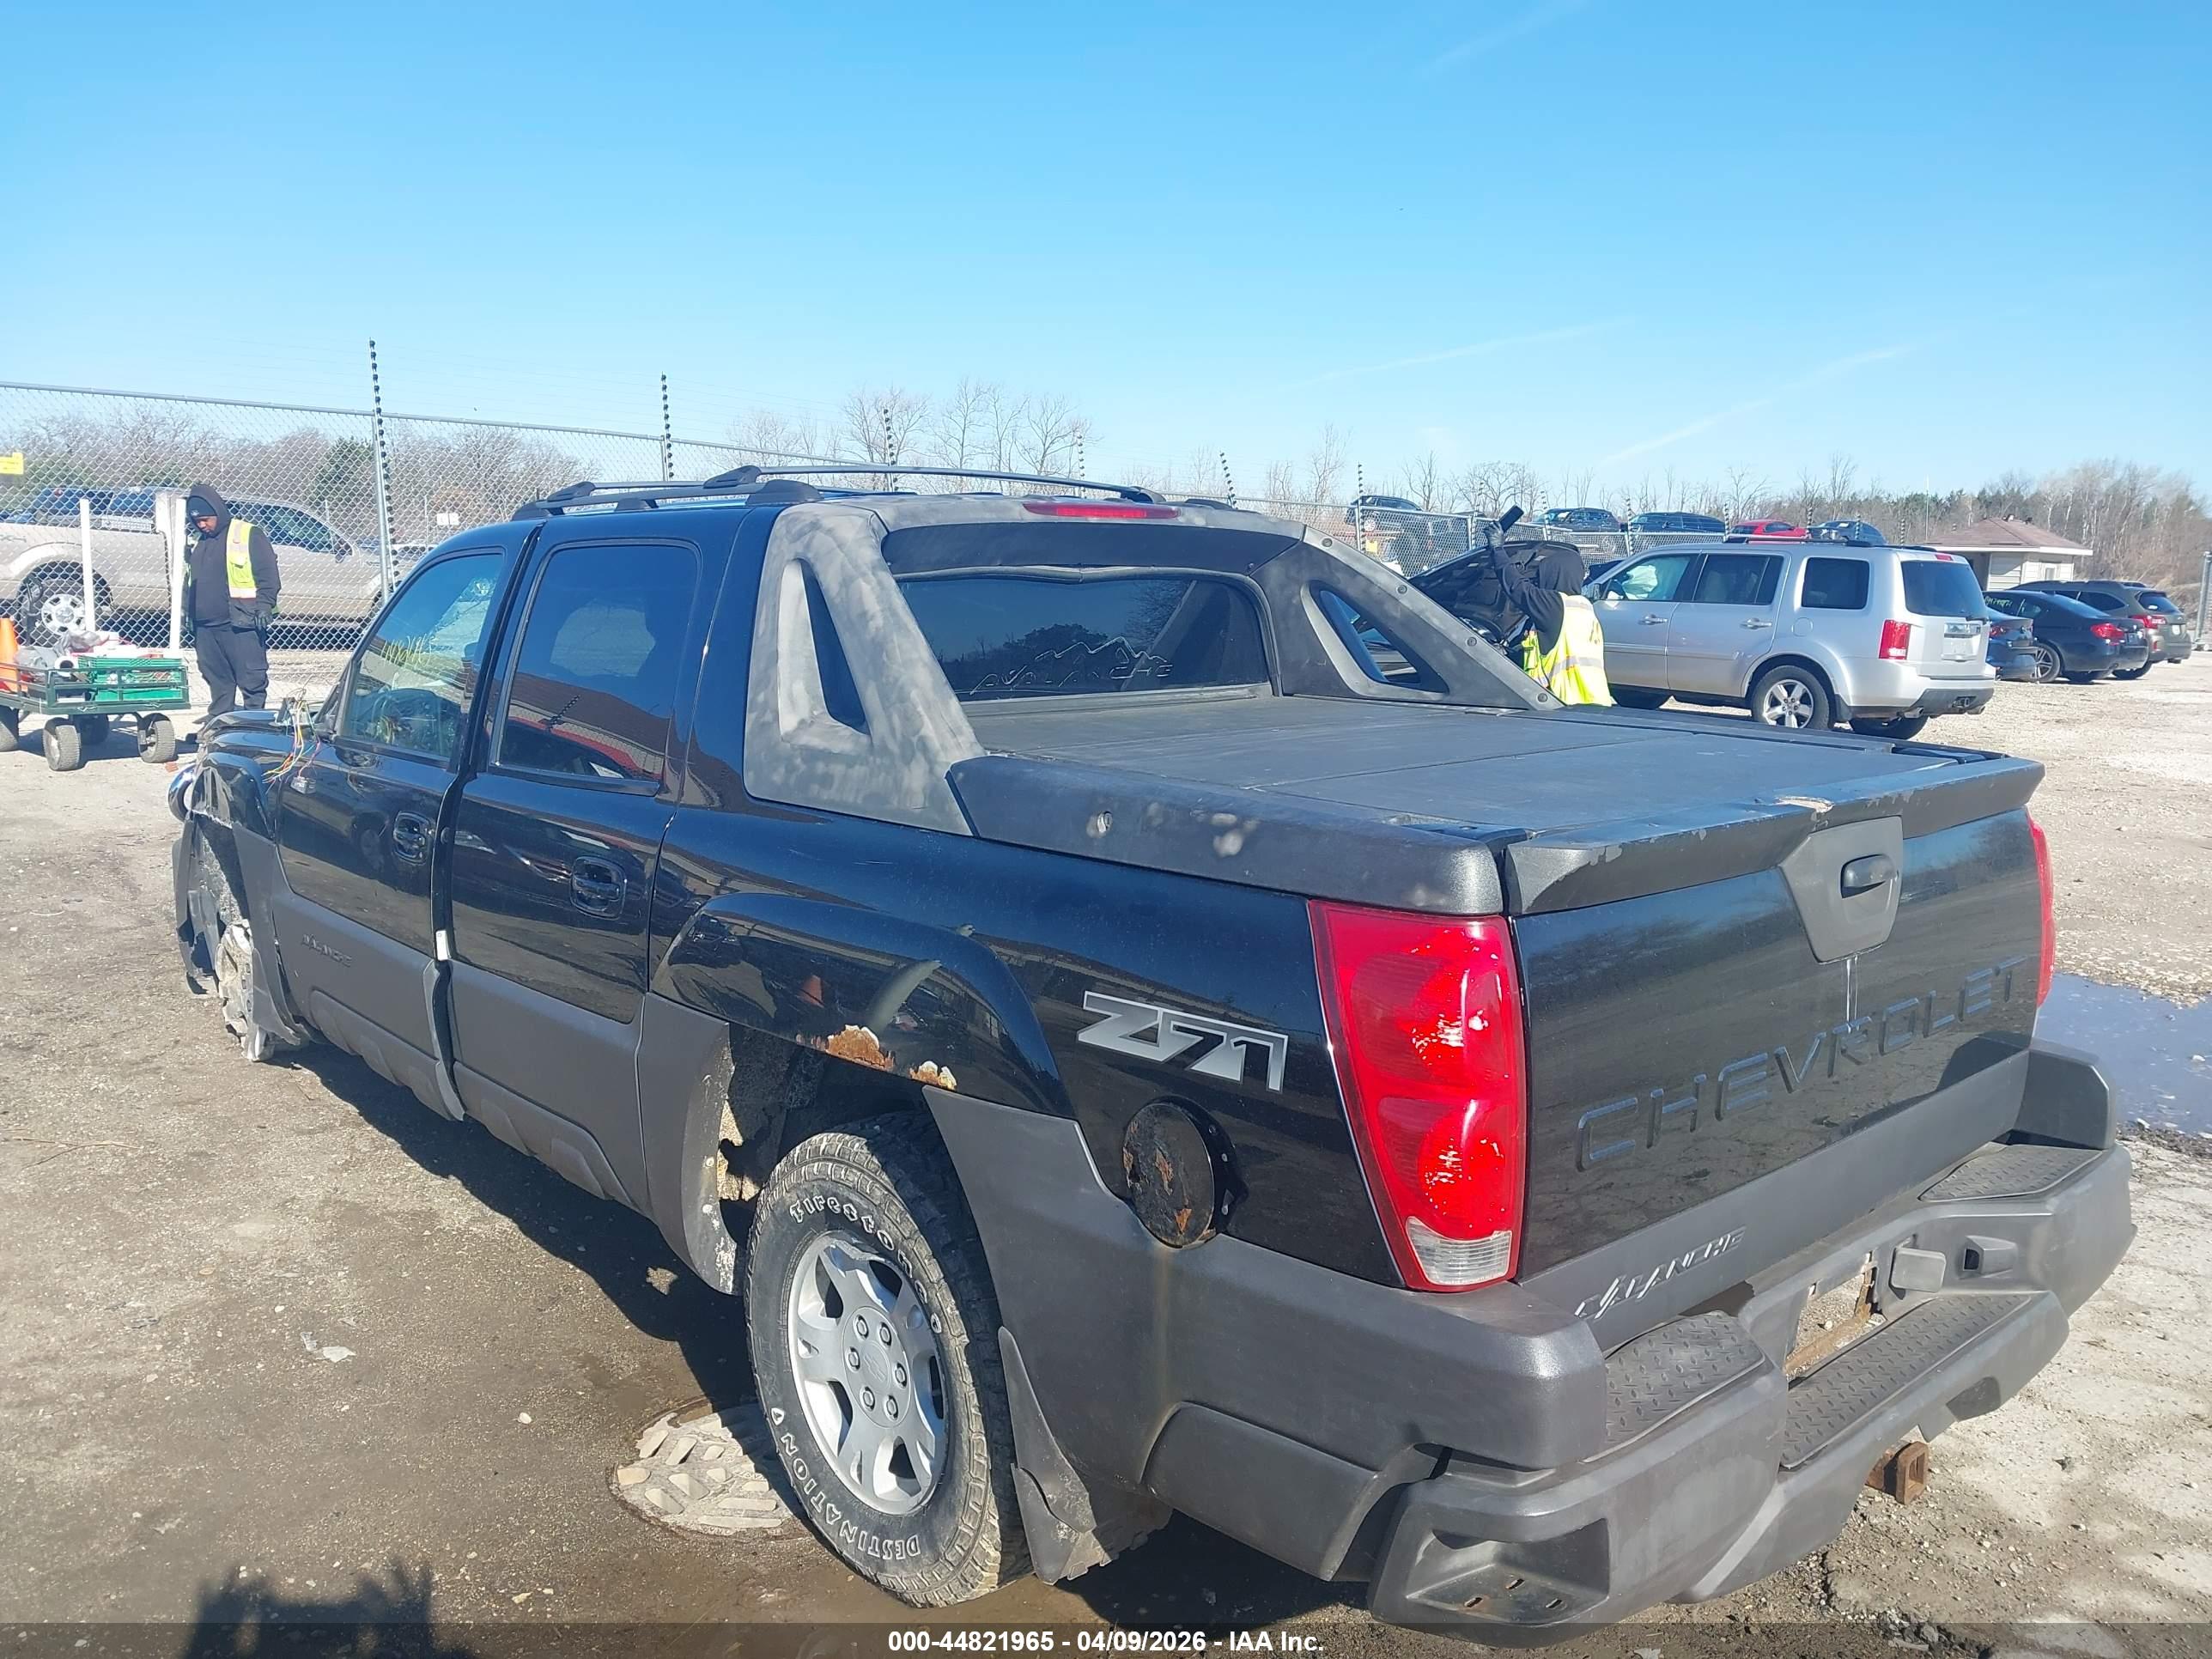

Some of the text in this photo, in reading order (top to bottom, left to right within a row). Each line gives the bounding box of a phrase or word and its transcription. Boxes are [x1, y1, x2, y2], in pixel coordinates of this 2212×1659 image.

[1077, 990, 1288, 1093] Z71
[1577, 955, 2028, 1172] CHEVROLET
[781, 1432, 921, 1560] DESTINATION
